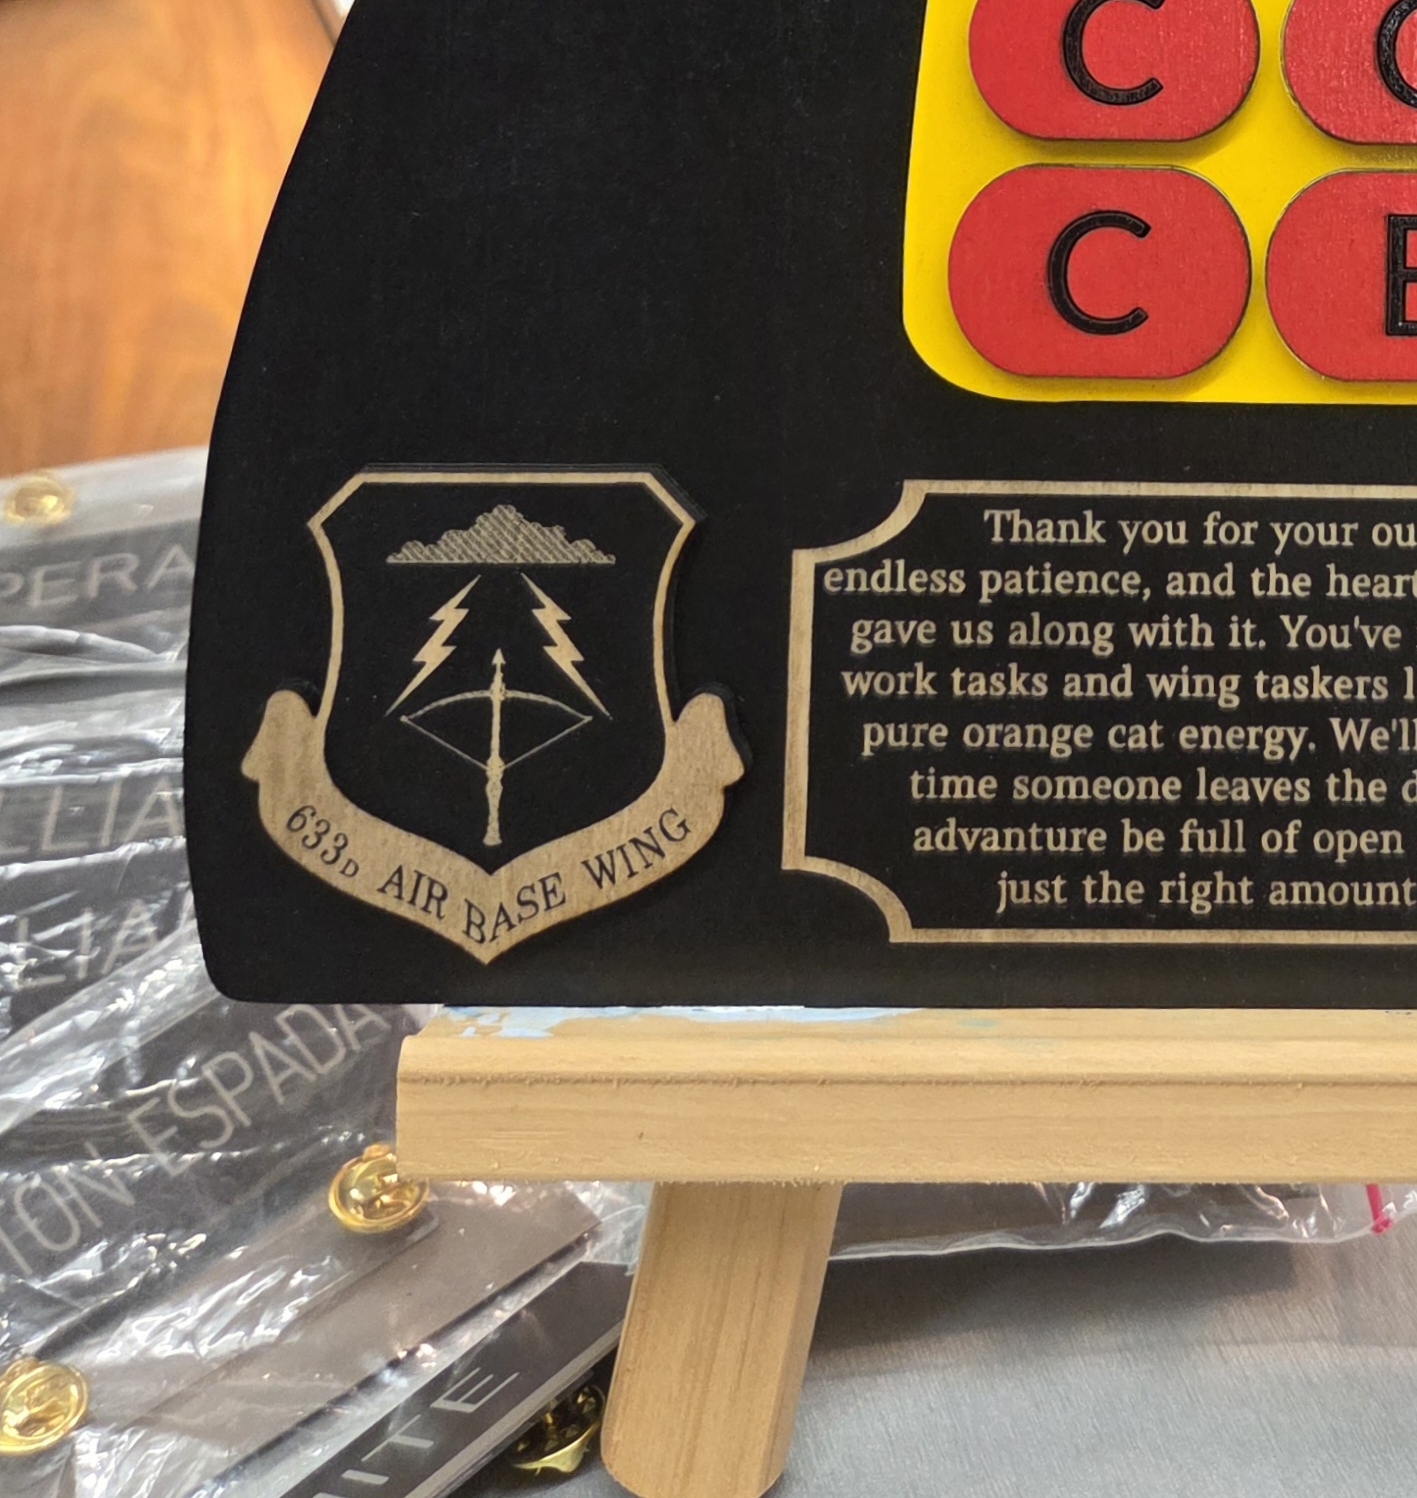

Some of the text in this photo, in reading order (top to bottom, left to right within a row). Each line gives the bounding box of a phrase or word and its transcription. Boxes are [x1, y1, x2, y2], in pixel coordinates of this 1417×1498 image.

[1047, 210, 1152, 335] C
[983, 509, 1107, 544] Thank
[1118, 520, 1189, 555] you
[1202, 511, 1259, 546] for
[1269, 521, 1359, 556] your
[824, 558, 967, 595] endless
[979, 562, 1151, 604] patience,
[1165, 561, 1236, 597] and
[1250, 562, 1312, 598] the
[850, 619, 937, 655] gave
[950, 620, 994, 646] us
[1008, 611, 1115, 657] along
[1127, 613, 1215, 648] with
[1228, 614, 1267, 649] it.
[1279, 614, 1402, 650] You've
[840, 661, 938, 697] work
[950, 662, 1049, 697] tasks
[1062, 663, 1134, 699] and
[1145, 665, 1241, 709] wing
[1254, 664, 1389, 701] taskers
[861, 722, 949, 758] pure
[962, 723, 1094, 759] orange
[1107, 719, 1165, 751] cat
[1178, 725, 1316, 762] energy.
[909, 766, 998, 800] time
[1012, 775, 1183, 802] someone
[1196, 766, 1311, 803] leaves
[1325, 767, 1388, 804] the
[912, 817, 1108, 853] advanture
[1121, 817, 1166, 854] be
[1179, 818, 1247, 854] full
[1260, 819, 1303, 855] of
[1312, 829, 1405, 864] open
[377, 863, 450, 920] AIR
[462, 872, 568, 945] BASE
[581, 807, 693, 890] WING
[996, 870, 1068, 914] just
[1081, 869, 1145, 905] the
[1159, 870, 1254, 914] right
[1268, 877, 1417, 907] amount
[128, 1004, 392, 1177] ESPADA
[313, 1366, 519, 1498] ITE
